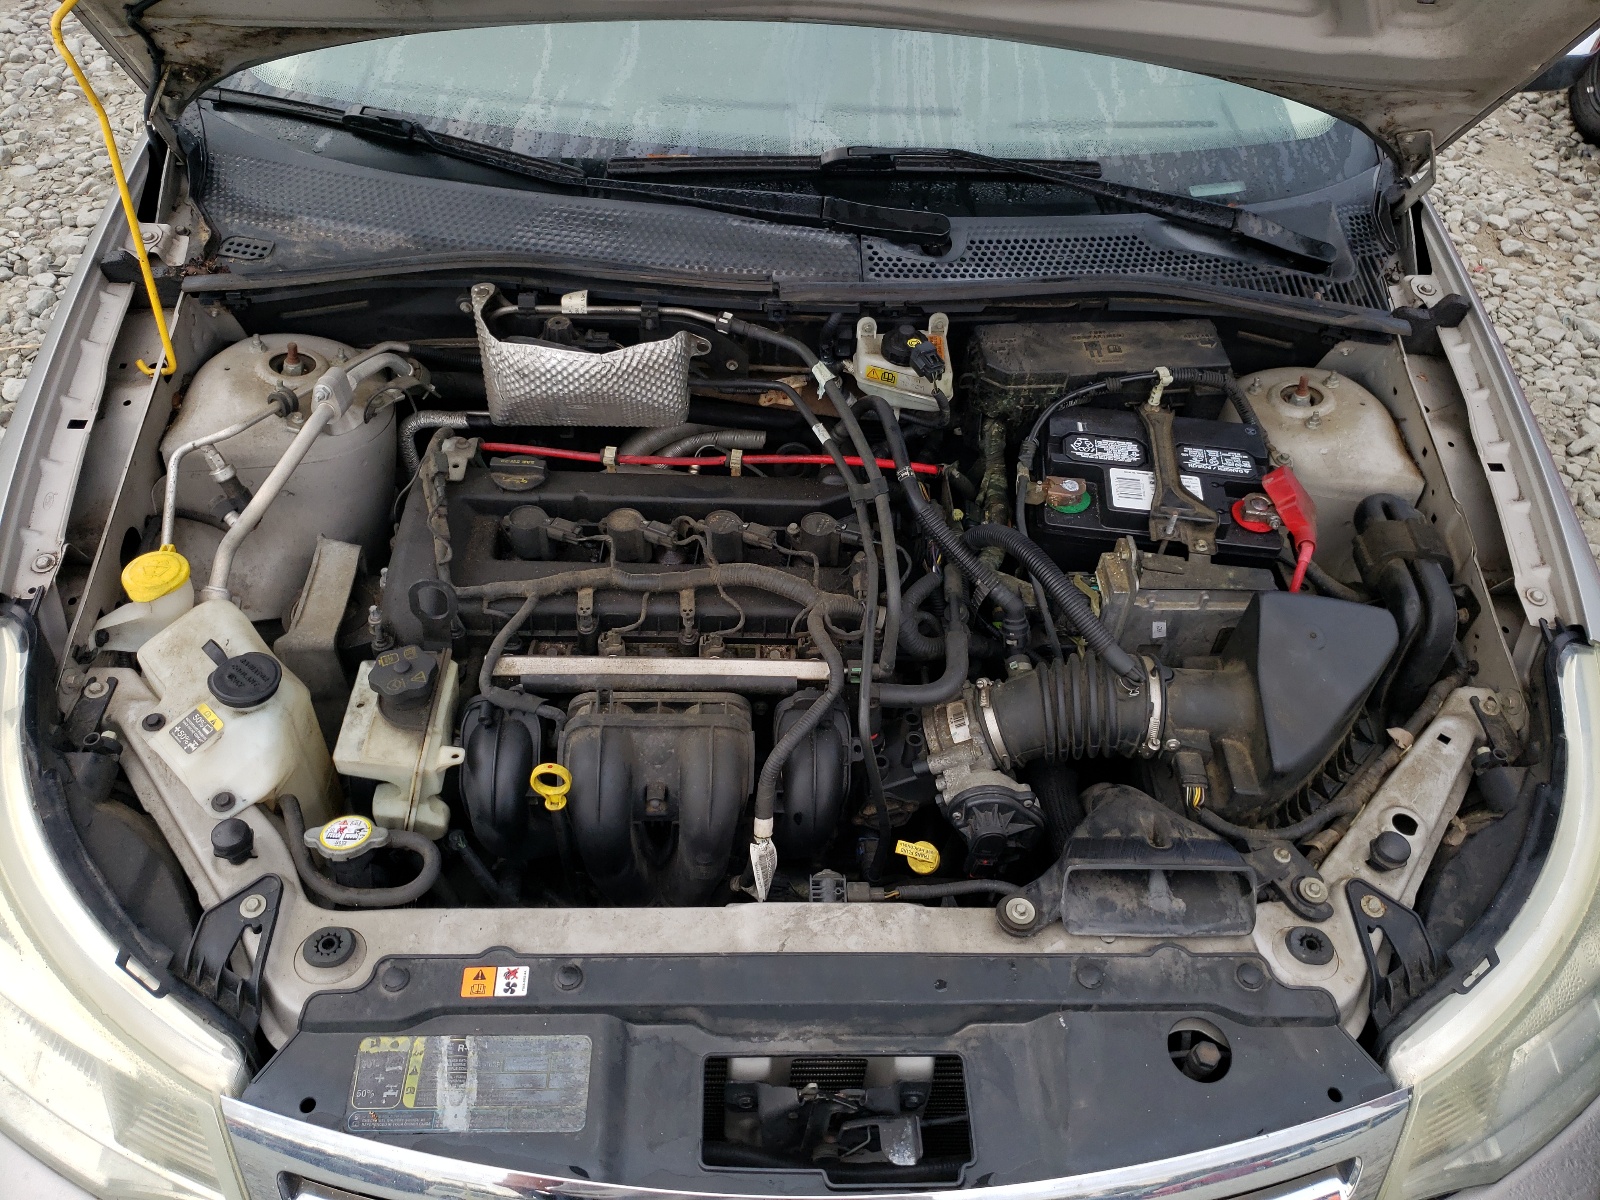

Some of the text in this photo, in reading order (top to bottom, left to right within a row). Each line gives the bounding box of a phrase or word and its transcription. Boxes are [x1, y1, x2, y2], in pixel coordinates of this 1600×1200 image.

[192, 713, 208, 729] 50%
[914, 851, 930, 860] TRANS
[356, 1089, 375, 1099] 50%
